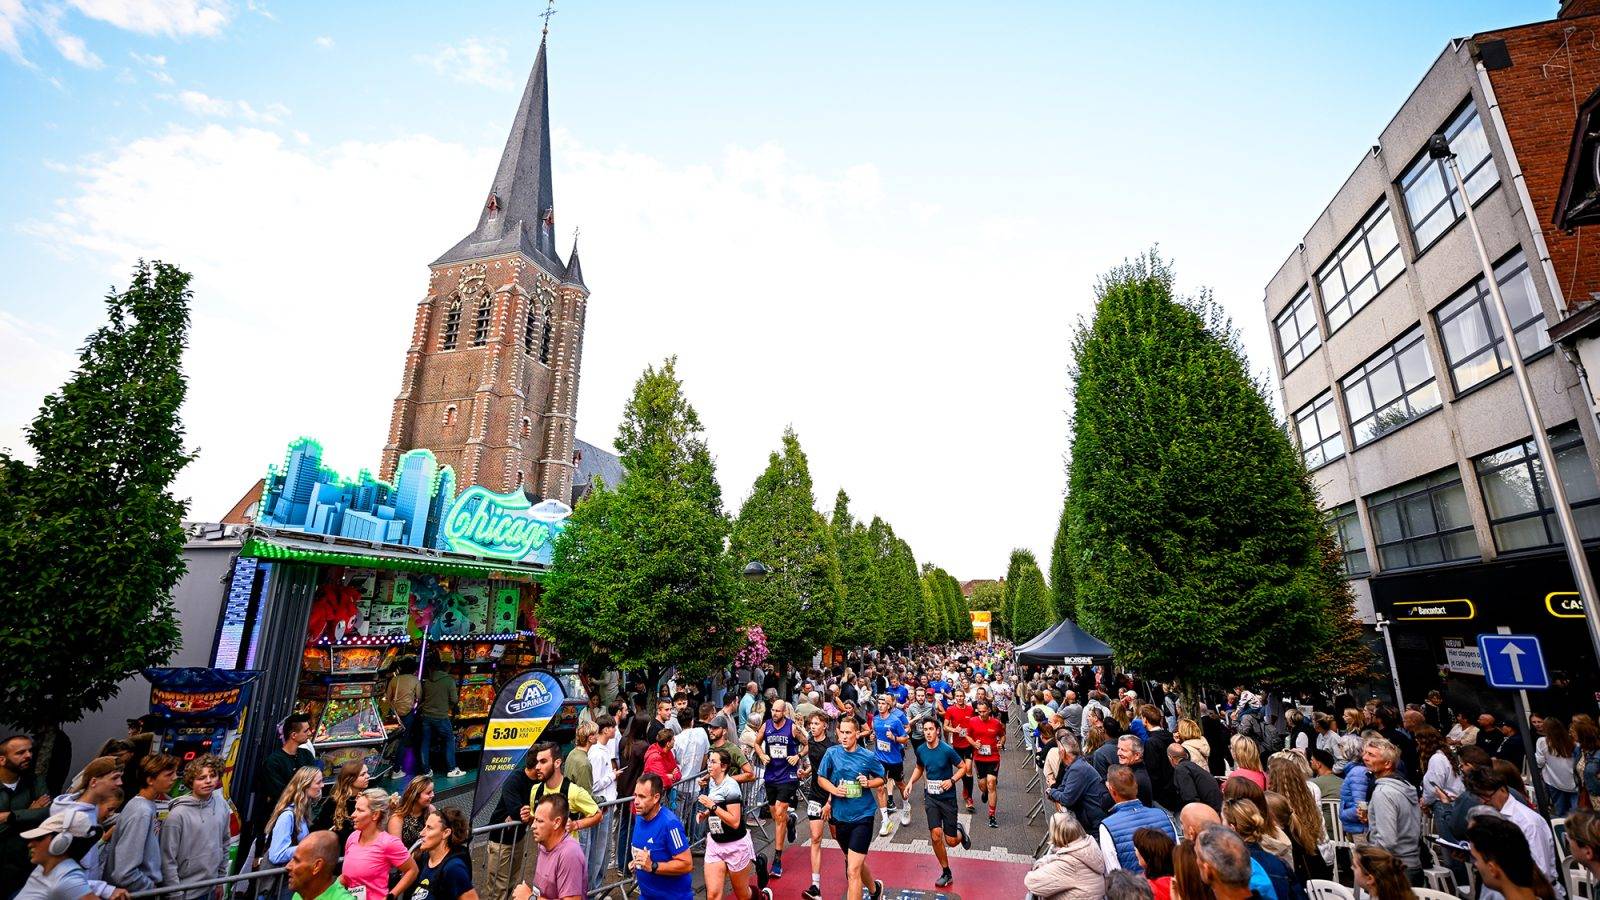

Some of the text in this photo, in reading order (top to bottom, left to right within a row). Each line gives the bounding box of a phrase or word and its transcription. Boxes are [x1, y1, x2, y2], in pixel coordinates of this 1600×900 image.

[444, 490, 551, 556] Chicago
[1418, 606, 1447, 615] Bancontact
[525, 686, 541, 701] AA
[520, 697, 544, 709] DRINK
[493, 727, 518, 740] 5:30
[767, 735, 788, 744] HORNETS
